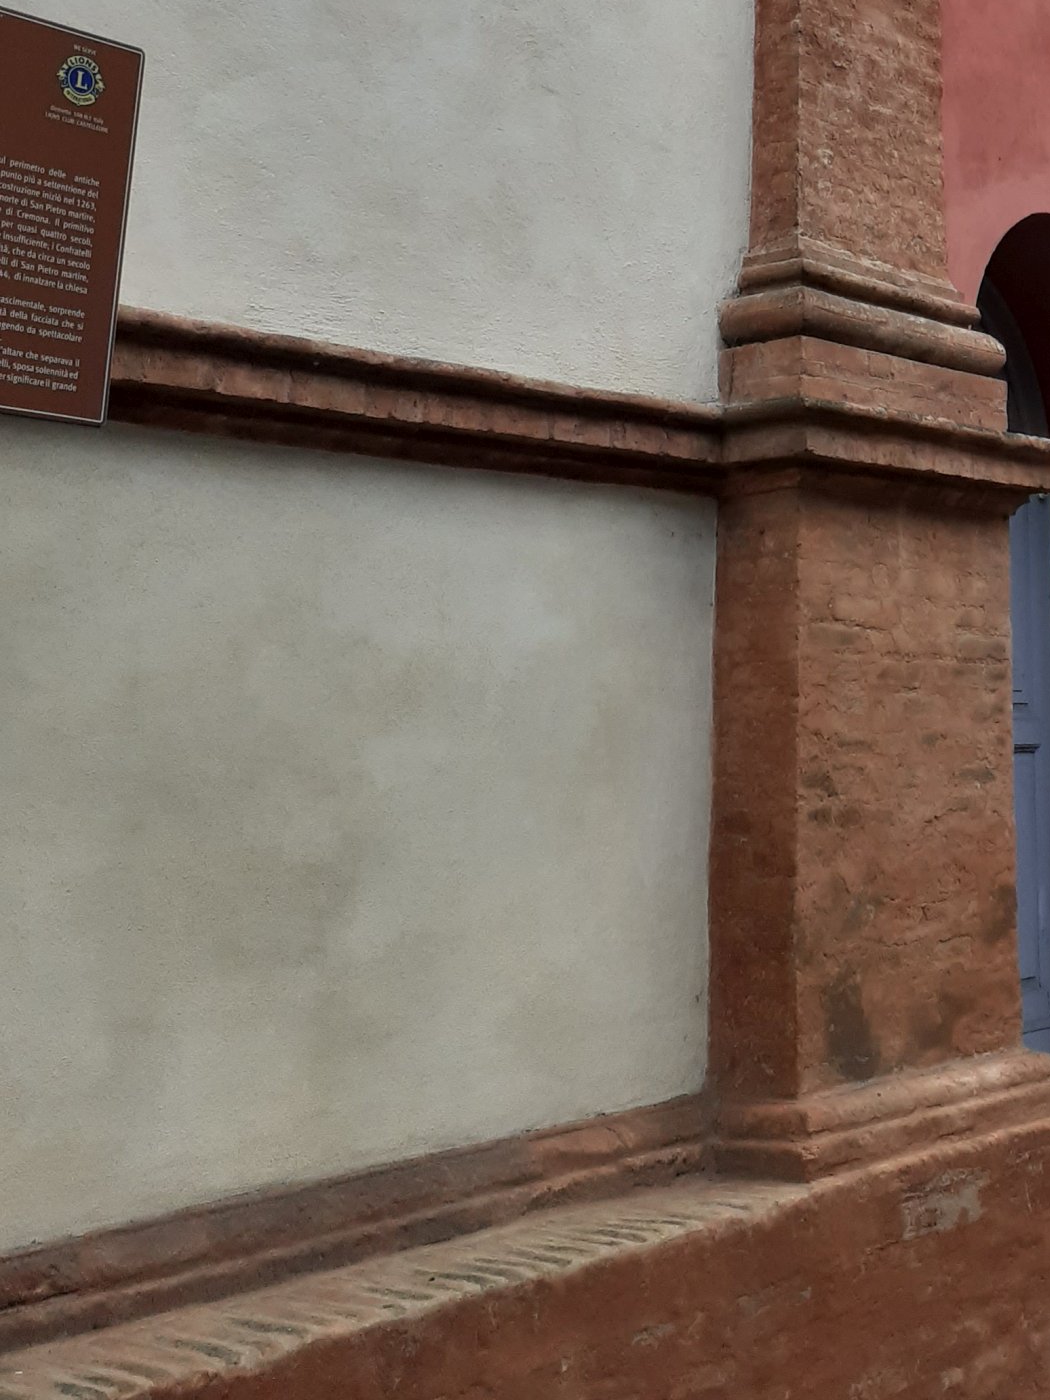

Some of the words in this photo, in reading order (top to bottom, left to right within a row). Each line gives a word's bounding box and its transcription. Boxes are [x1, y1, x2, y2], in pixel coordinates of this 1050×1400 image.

[69, 56, 98, 73] LIONS
[76, 70, 88, 90] L
[0, 169, 22, 181] punto
[23, 174, 36, 184] più
[43, 179, 86, 197] settentrione
[87, 189, 99, 199] del
[9, 159, 45, 174] perimetro
[48, 168, 67, 179] delle
[74, 175, 100, 187] antiche
[0, 182, 41, 197] costruzione
[42, 190, 62, 203] iniziò
[63, 197, 75, 206] nel
[77, 199, 97, 212] 1263,
[5, 207, 14, 216] di
[17, 209, 51, 225] Cremona.
[54, 218, 60, 227] Il
[63, 221, 95, 235] primitivo
[20, 198, 28, 207] di
[30, 200, 44, 210] San
[45, 203, 67, 216] Pietro
[68, 210, 96, 224] martire,
[1, 220, 14, 229] per
[17, 223, 38, 234] quasi
[40, 228, 67, 241] quattro
[70, 235, 93, 248] secoli,
[12, 246, 26, 258] che
[26, 249, 37, 259] da
[38, 252, 55, 263] circa
[56, 256, 66, 266] un
[67, 258, 91, 271] secolo
[51, 241, 55, 250] i
[55, 242, 92, 259] Confratelli
[10, 259, 19, 268] di
[20, 261, 35, 271] San
[37, 263, 59, 276] Pietro
[61, 270, 89, 284] martire,
[14, 272, 22, 281] di
[22, 273, 57, 288] innalzare
[57, 280, 64, 290] la
[65, 282, 88, 295] chiesa
[9, 309, 28, 320] della
[31, 312, 59, 327] facciata
[61, 319, 75, 329] che
[77, 322, 84, 331] si
[48, 305, 86, 319] sorprende
[26, 325, 36, 334] da
[38, 328, 83, 343] spettacolare
[25, 350, 39, 361] che
[40, 353, 73, 367] separava
[75, 358, 80, 367] il
[12, 361, 34, 372] sposa
[35, 364, 69, 378] solennità
[69, 370, 79, 380] ed
[6, 372, 45, 388] significare
[45, 378, 50, 387] il
[51, 381, 77, 392] grande
